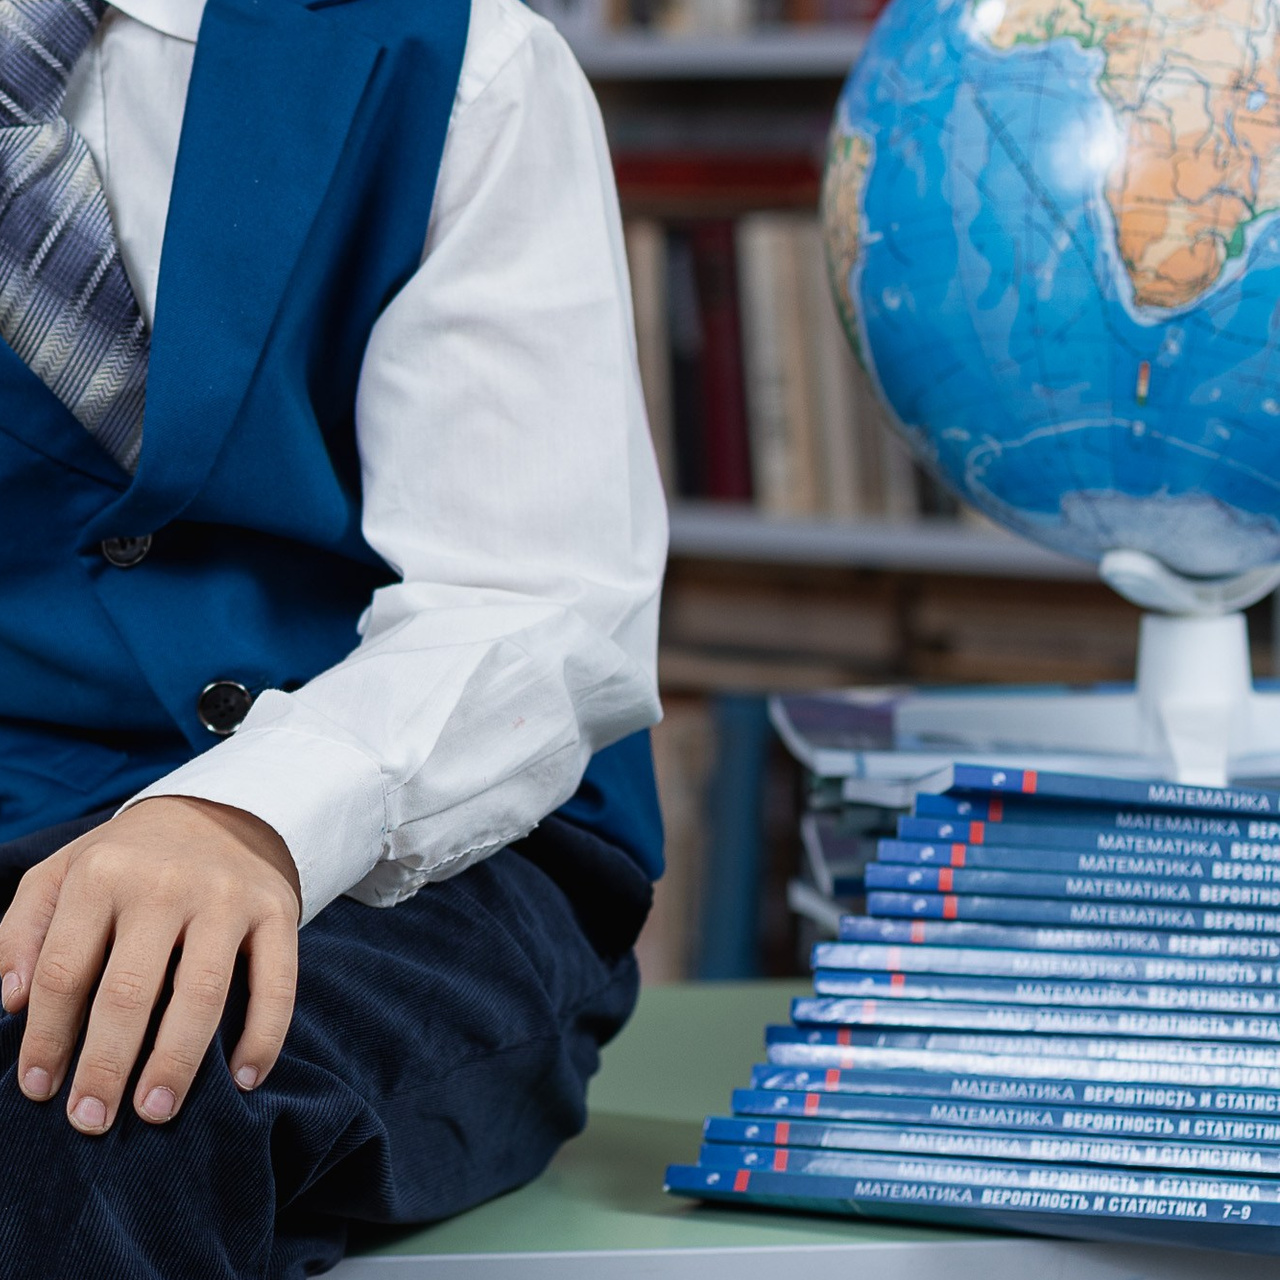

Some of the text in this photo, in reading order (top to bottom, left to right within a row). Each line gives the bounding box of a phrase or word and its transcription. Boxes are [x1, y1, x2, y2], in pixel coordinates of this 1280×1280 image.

[1148, 785, 1271, 812] МАТЕМАТИКА
[1115, 812, 1280, 841] МАТЕМАТИКА ВЕР
[1097, 833, 1222, 858] МАТЕМАТИКА
[1078, 854, 1204, 879] МАТЕМАТИКА
[1066, 877, 1191, 902] МАТЕМАТИКА
[1070, 904, 1196, 928] МАТЕМАТИКА
[1036, 928, 1280, 957] МАТЕМАТИКА ВЕРОЯТНОСТЬ
[1145, 960, 1258, 984] ВЕРОЯТНОСТЬ
[1147, 986, 1260, 1010] ВЕРОЯТНОСТЬ
[951, 1079, 1075, 1101] МАТЕМАТИКА
[1084, 1085, 1196, 1108] ВЕРОЯТНОСТЬ
[1199, 1091, 1212, 1108] И
[931, 1104, 1054, 1127] МАТЕМАТИКА
[1062, 1111, 1175, 1134] ВЕРОЯТНОСТЬ
[1178, 1118, 1191, 1135] И
[899, 1132, 1262, 1168] МАТЕМАТИКА ВЕРОЯТНОСТЬ И СТАТИСТИКА
[897, 1162, 1261, 1200] МАТЕМАТИКА ВЕРОЯТНОСТЬ И СТАТИСТИКА
[854, 1180, 1252, 1220] МАТЕМАТИКА ВЕРОЯТНОСТЬ И СТАТИСТИКА 7-9
